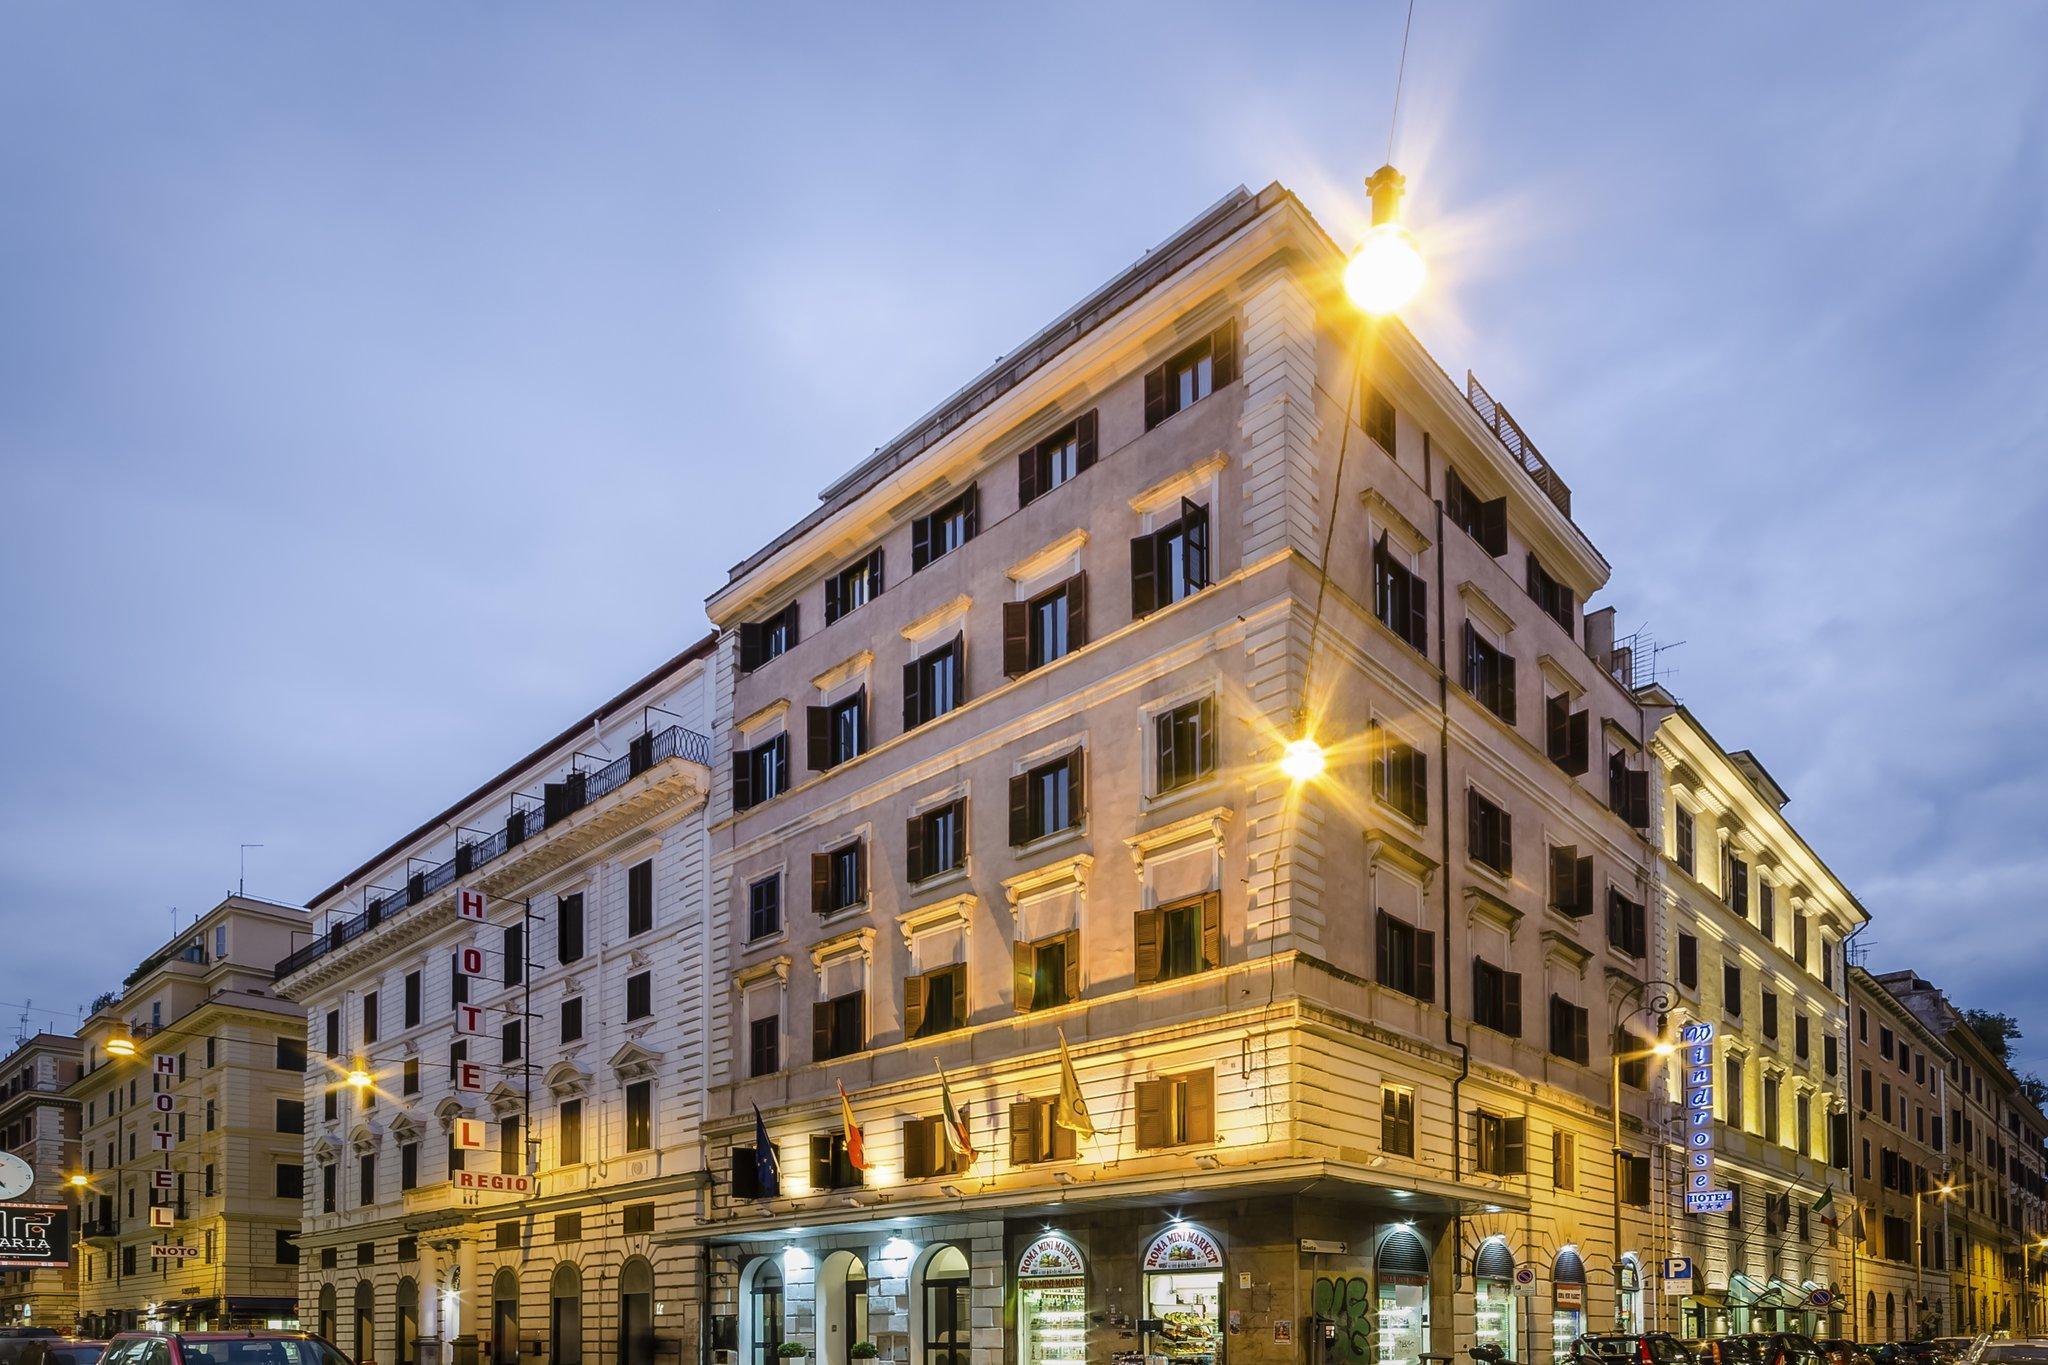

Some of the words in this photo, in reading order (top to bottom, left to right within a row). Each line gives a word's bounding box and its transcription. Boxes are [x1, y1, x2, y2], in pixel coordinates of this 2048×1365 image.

[461, 891, 483, 1147] HOTEL
[1686, 1023, 1711, 1187] Windrose
[156, 1055, 174, 1226] HOTEL
[460, 1173, 529, 1191] REGIO
[1688, 1192, 1731, 1203] HOTEL
[155, 1247, 198, 1256] NOTO
[1020, 1248, 1039, 1273] ROMA
[1037, 1240, 1054, 1254] MINI
[1054, 1241, 1081, 1270] MARKET
[1146, 1240, 1168, 1267] ROMA
[1167, 1231, 1186, 1245] MINI
[1187, 1231, 1219, 1264] MARKET
[1669, 1259, 1687, 1278] P
